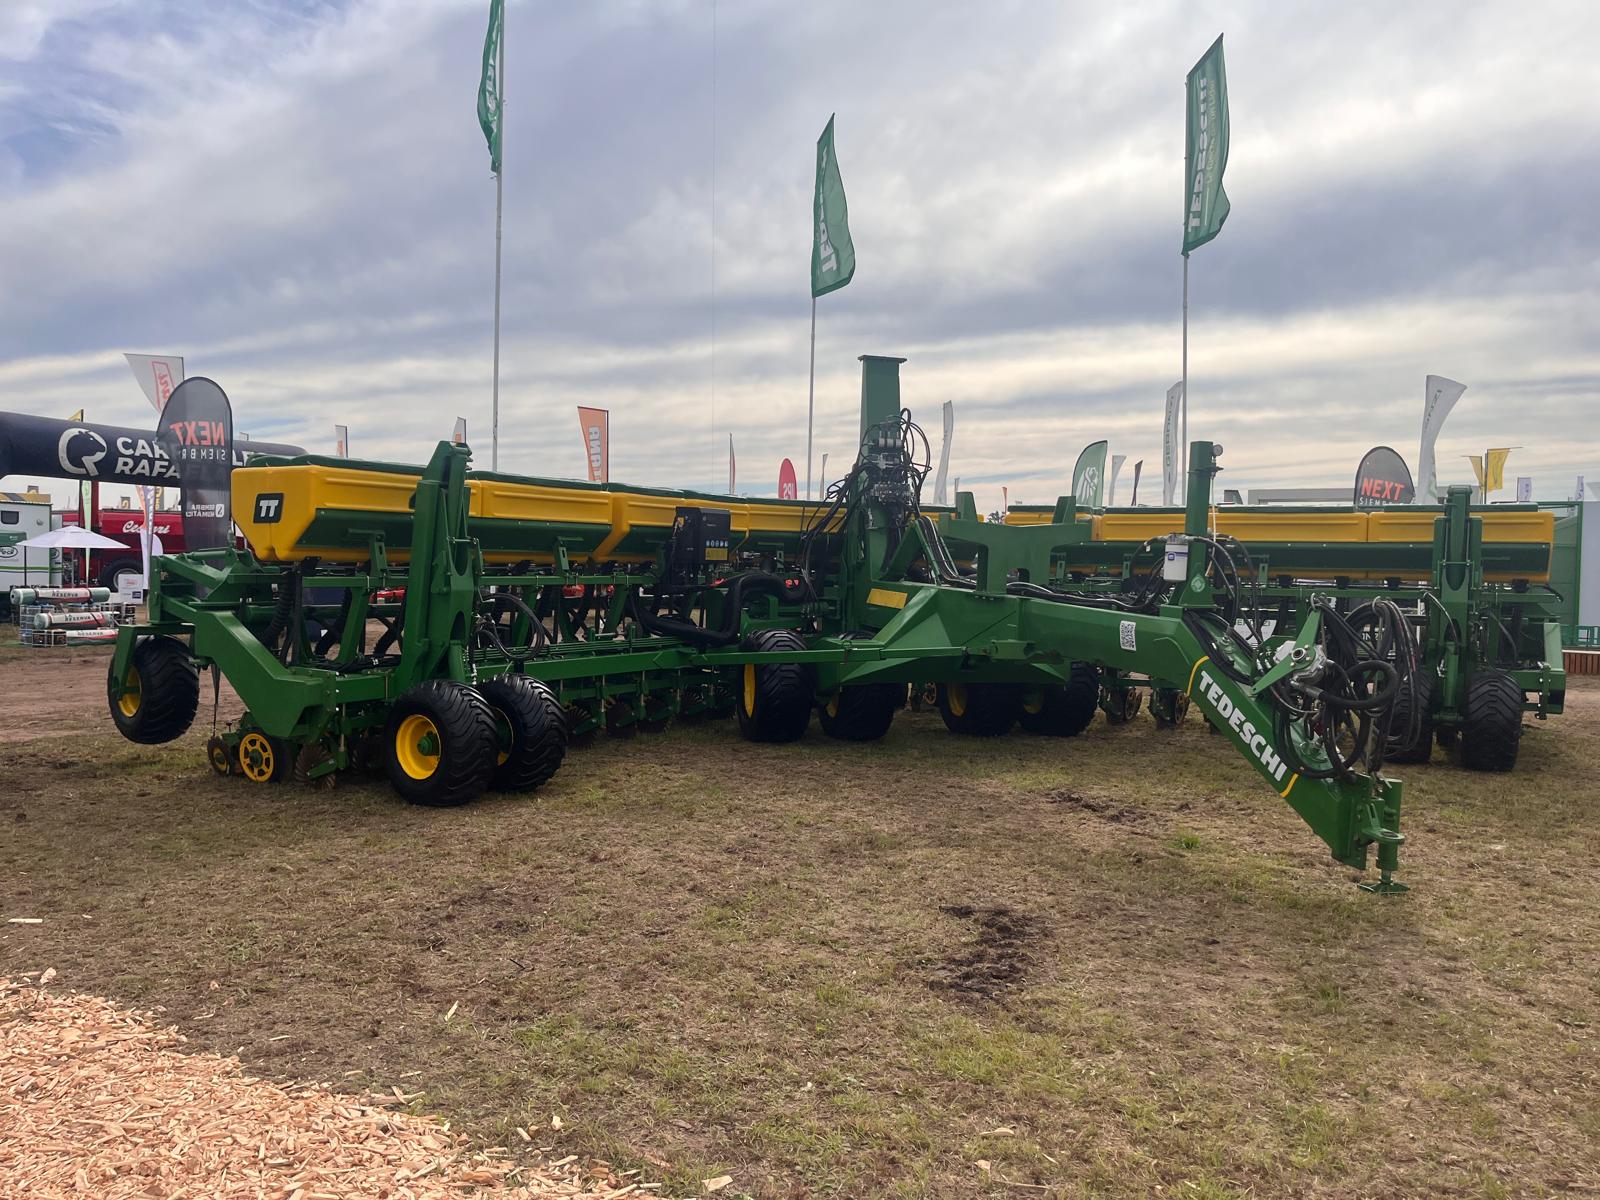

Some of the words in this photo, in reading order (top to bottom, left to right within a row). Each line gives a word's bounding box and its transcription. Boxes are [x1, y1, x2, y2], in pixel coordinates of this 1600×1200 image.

[1188, 77, 1207, 233] TEDESCHI
[1361, 478, 1405, 501] NEXT
[1199, 671, 1288, 782] TEDESCHI
